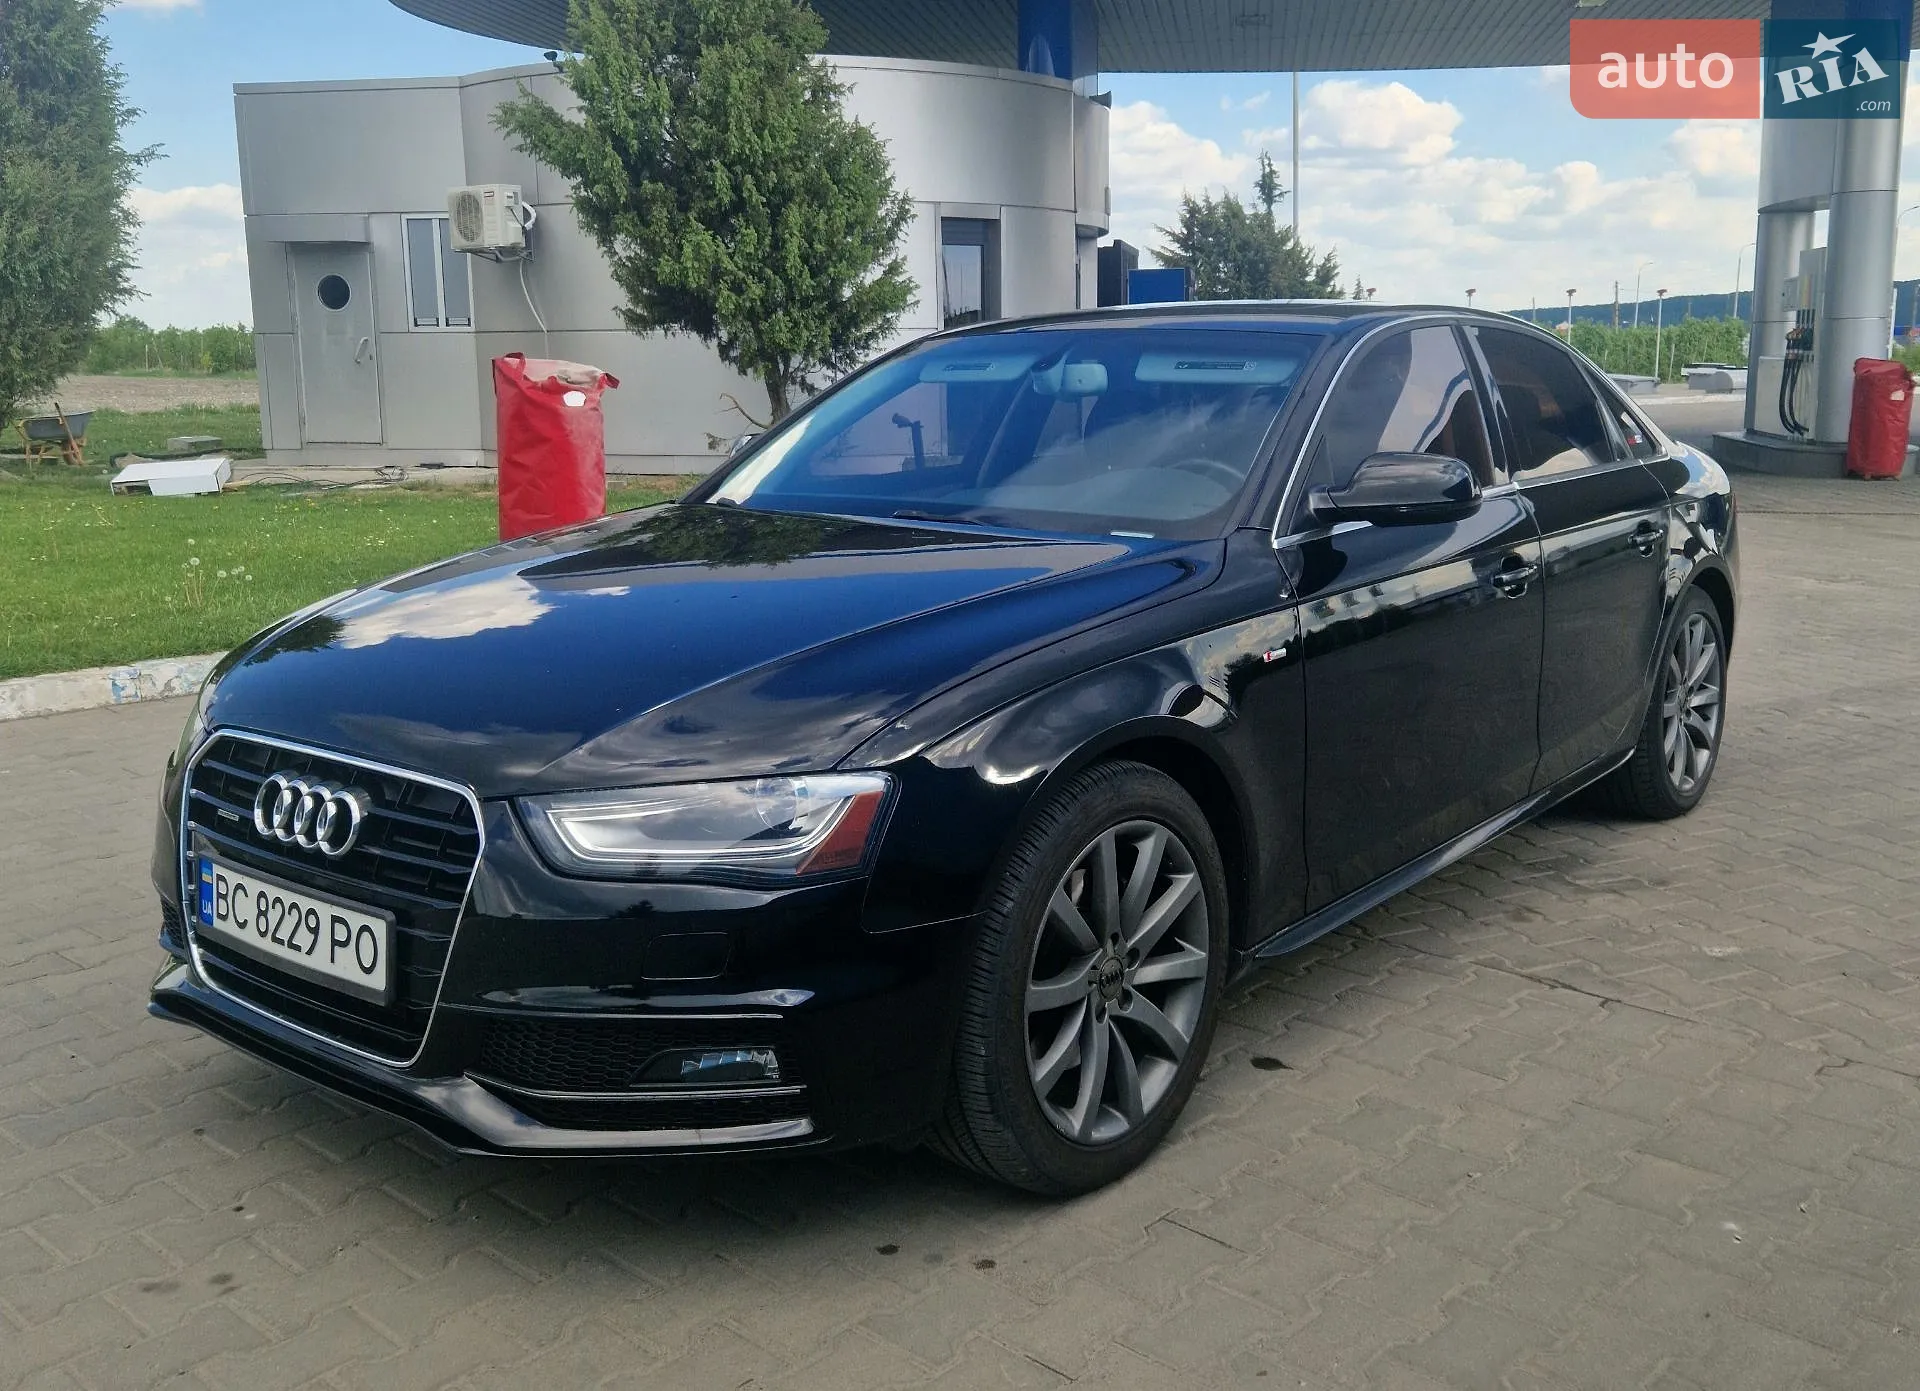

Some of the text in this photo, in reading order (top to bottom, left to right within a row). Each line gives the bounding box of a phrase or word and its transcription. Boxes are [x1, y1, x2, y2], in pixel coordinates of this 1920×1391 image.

[202, 898, 213, 916] UA
[216, 874, 378, 974] BC 8229 PO
